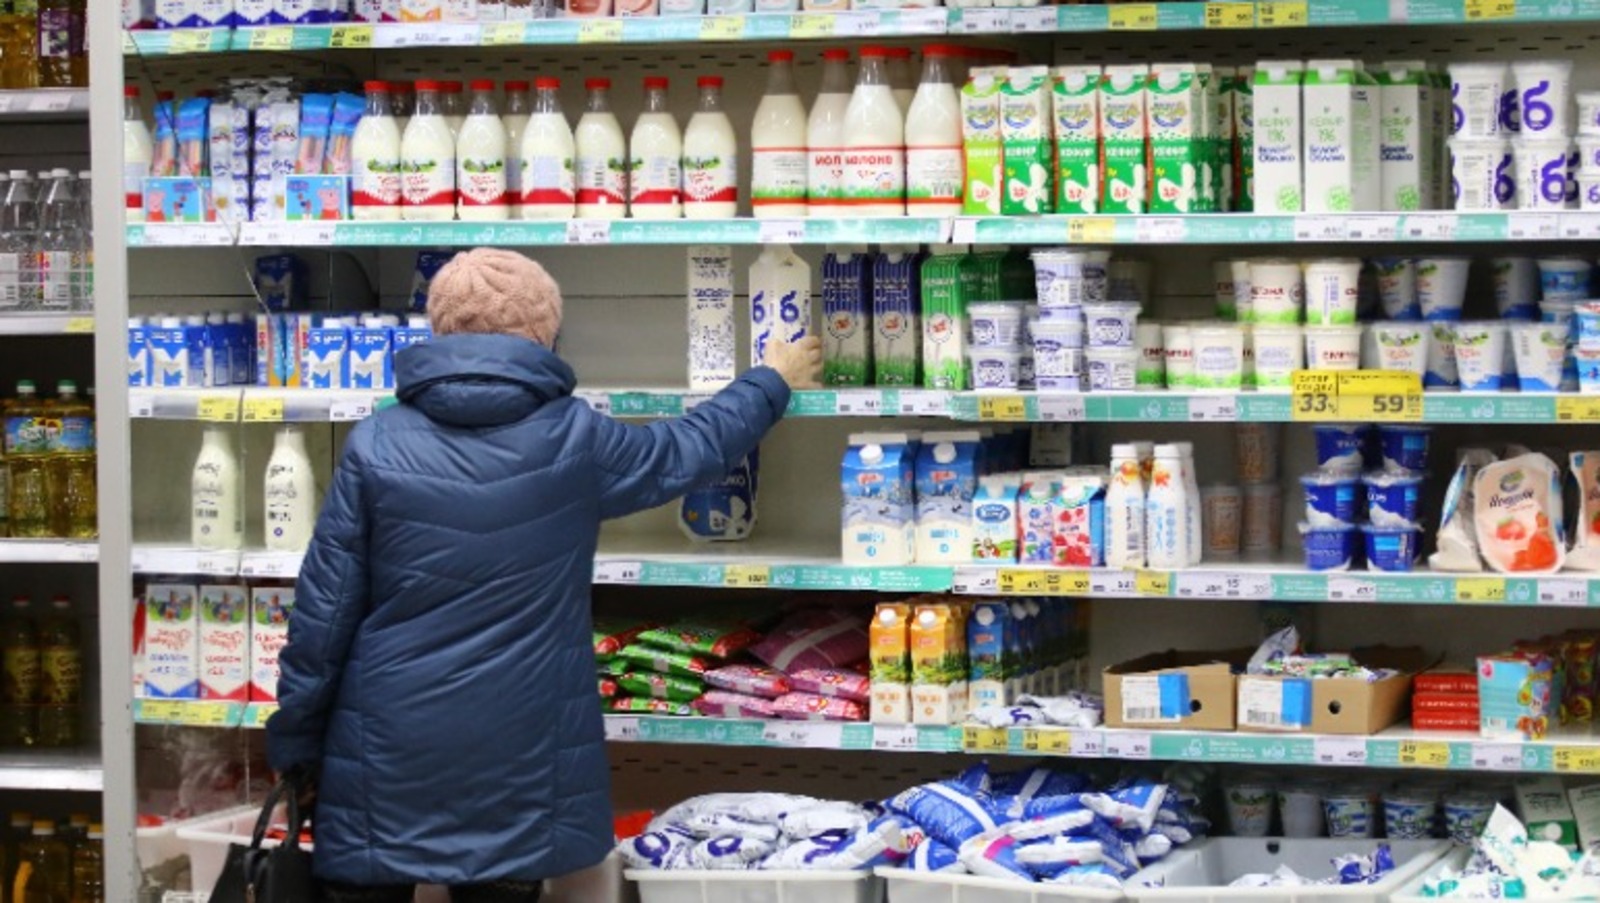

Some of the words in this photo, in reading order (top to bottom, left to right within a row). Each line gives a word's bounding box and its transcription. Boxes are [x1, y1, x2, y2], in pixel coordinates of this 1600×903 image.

[1523, 81, 1553, 131] б
[780, 290, 799, 323] б
[1373, 394, 1404, 413] 59
